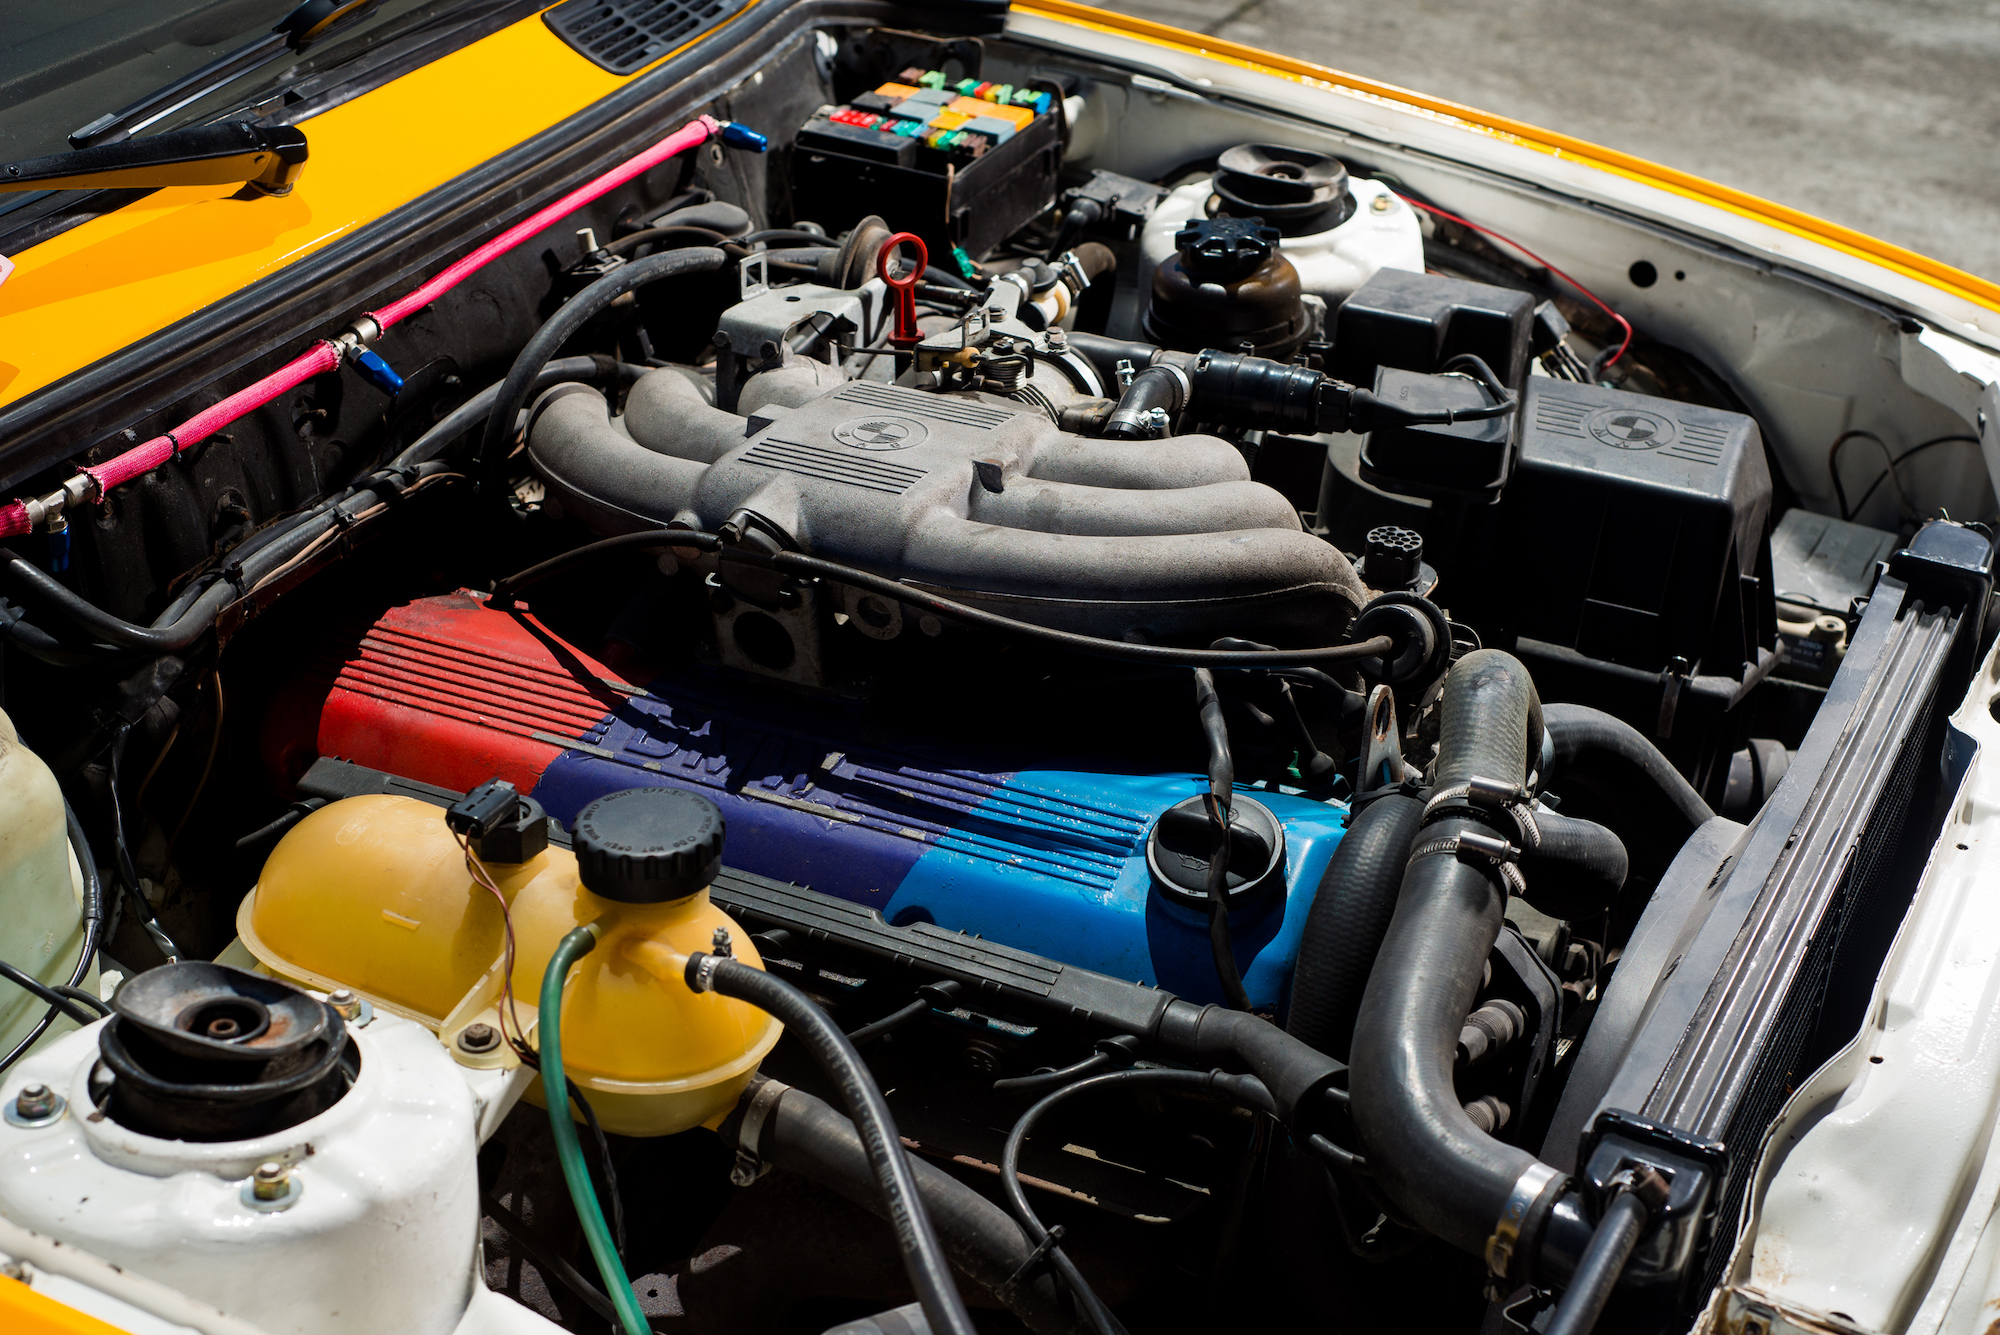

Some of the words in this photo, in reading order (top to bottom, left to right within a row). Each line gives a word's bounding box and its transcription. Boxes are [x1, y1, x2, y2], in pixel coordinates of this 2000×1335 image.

[603, 790, 633, 803] NICHT
[603, 841, 633, 852] OPEN
[642, 845, 665, 853] NOT
[876, 1162, 895, 1189] DIN
[888, 1194, 918, 1254] CAUTEX
